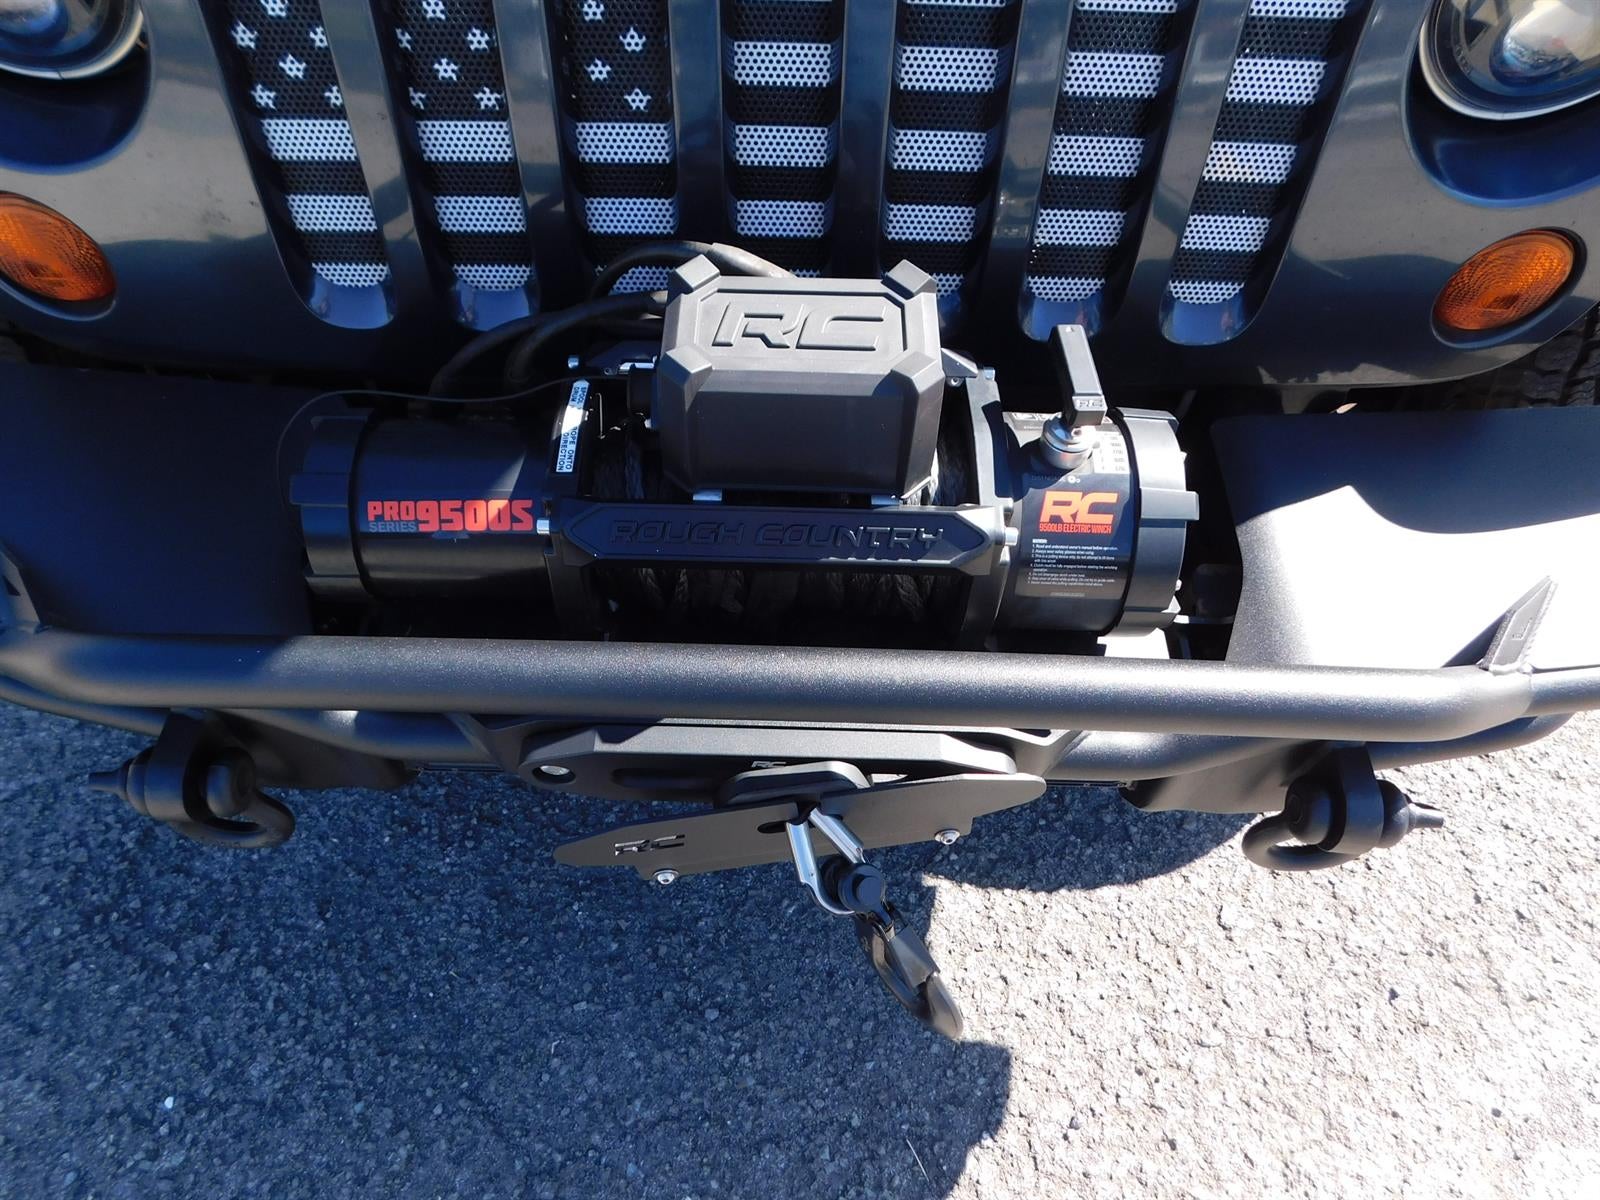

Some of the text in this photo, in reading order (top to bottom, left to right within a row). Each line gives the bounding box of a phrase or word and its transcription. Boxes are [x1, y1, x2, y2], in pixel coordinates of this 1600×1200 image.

[712, 300, 886, 351] RC
[557, 432, 569, 471] DIRECTION
[565, 449, 574, 470] ONTO
[367, 499, 534, 532] PRO 9500S
[1039, 490, 1118, 523] RC
[368, 521, 417, 533] SERIES
[610, 519, 945, 550] ROUGH COUNTRY
[1063, 523, 1091, 533] ELECTRIC
[1091, 524, 1112, 534] WINCH
